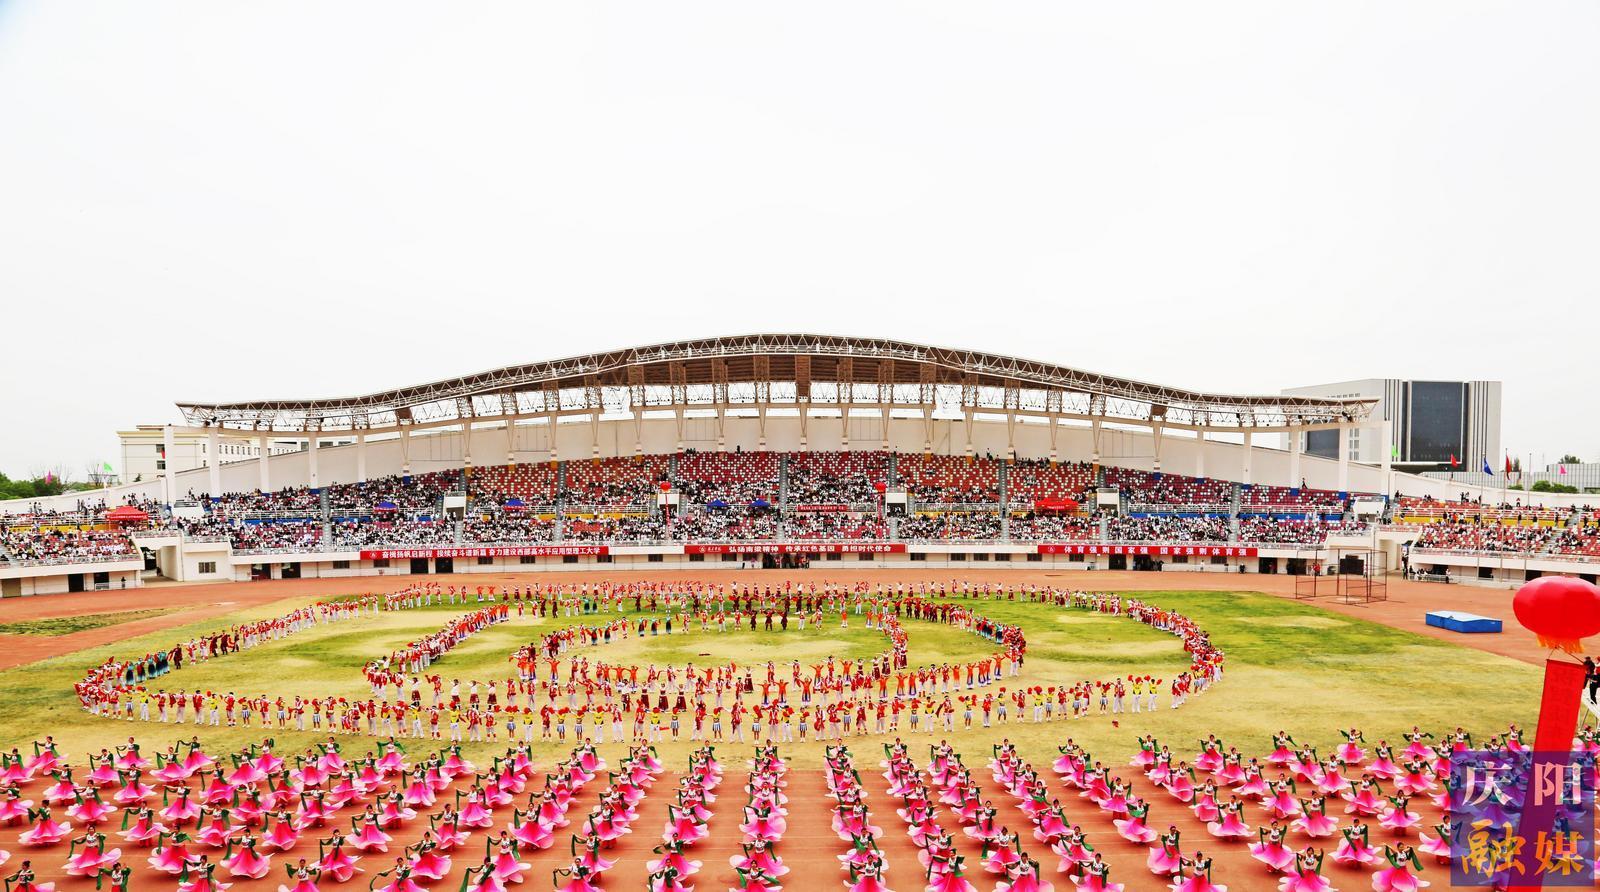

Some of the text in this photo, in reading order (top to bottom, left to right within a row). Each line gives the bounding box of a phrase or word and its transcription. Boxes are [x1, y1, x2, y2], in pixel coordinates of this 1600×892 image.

[489, 547, 600, 556] 奋力建设西部高水平应用型理工大学
[1160, 547, 1247, 555] 国家强则体育强
